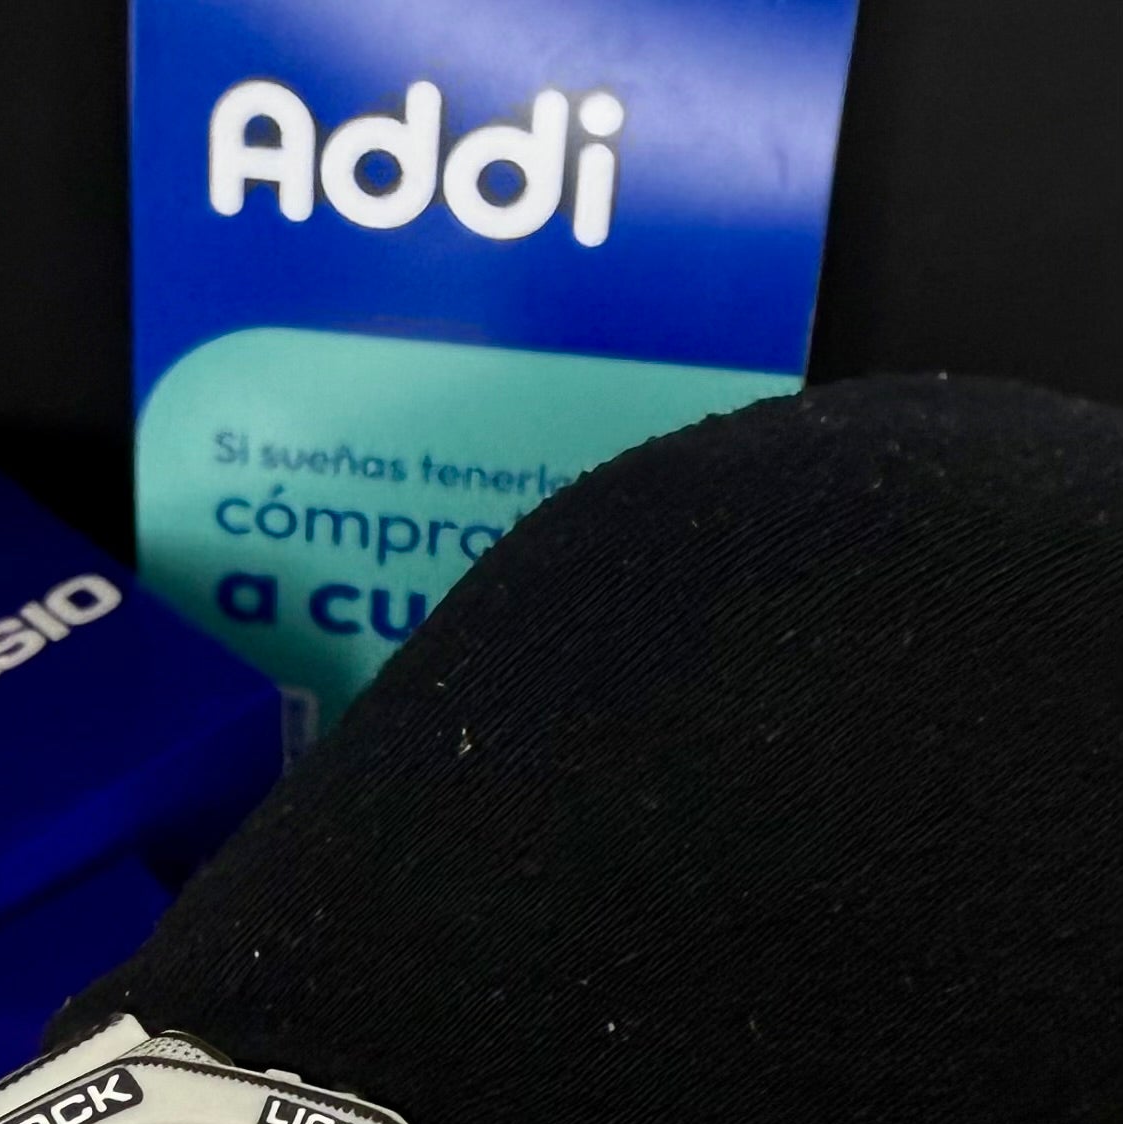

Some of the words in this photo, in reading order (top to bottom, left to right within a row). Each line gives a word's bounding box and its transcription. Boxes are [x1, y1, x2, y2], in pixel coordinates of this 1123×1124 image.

[209, 80, 624, 247] Addi
[214, 431, 249, 465] Si
[259, 443, 408, 483] sueñas
[216, 571, 277, 626] a
